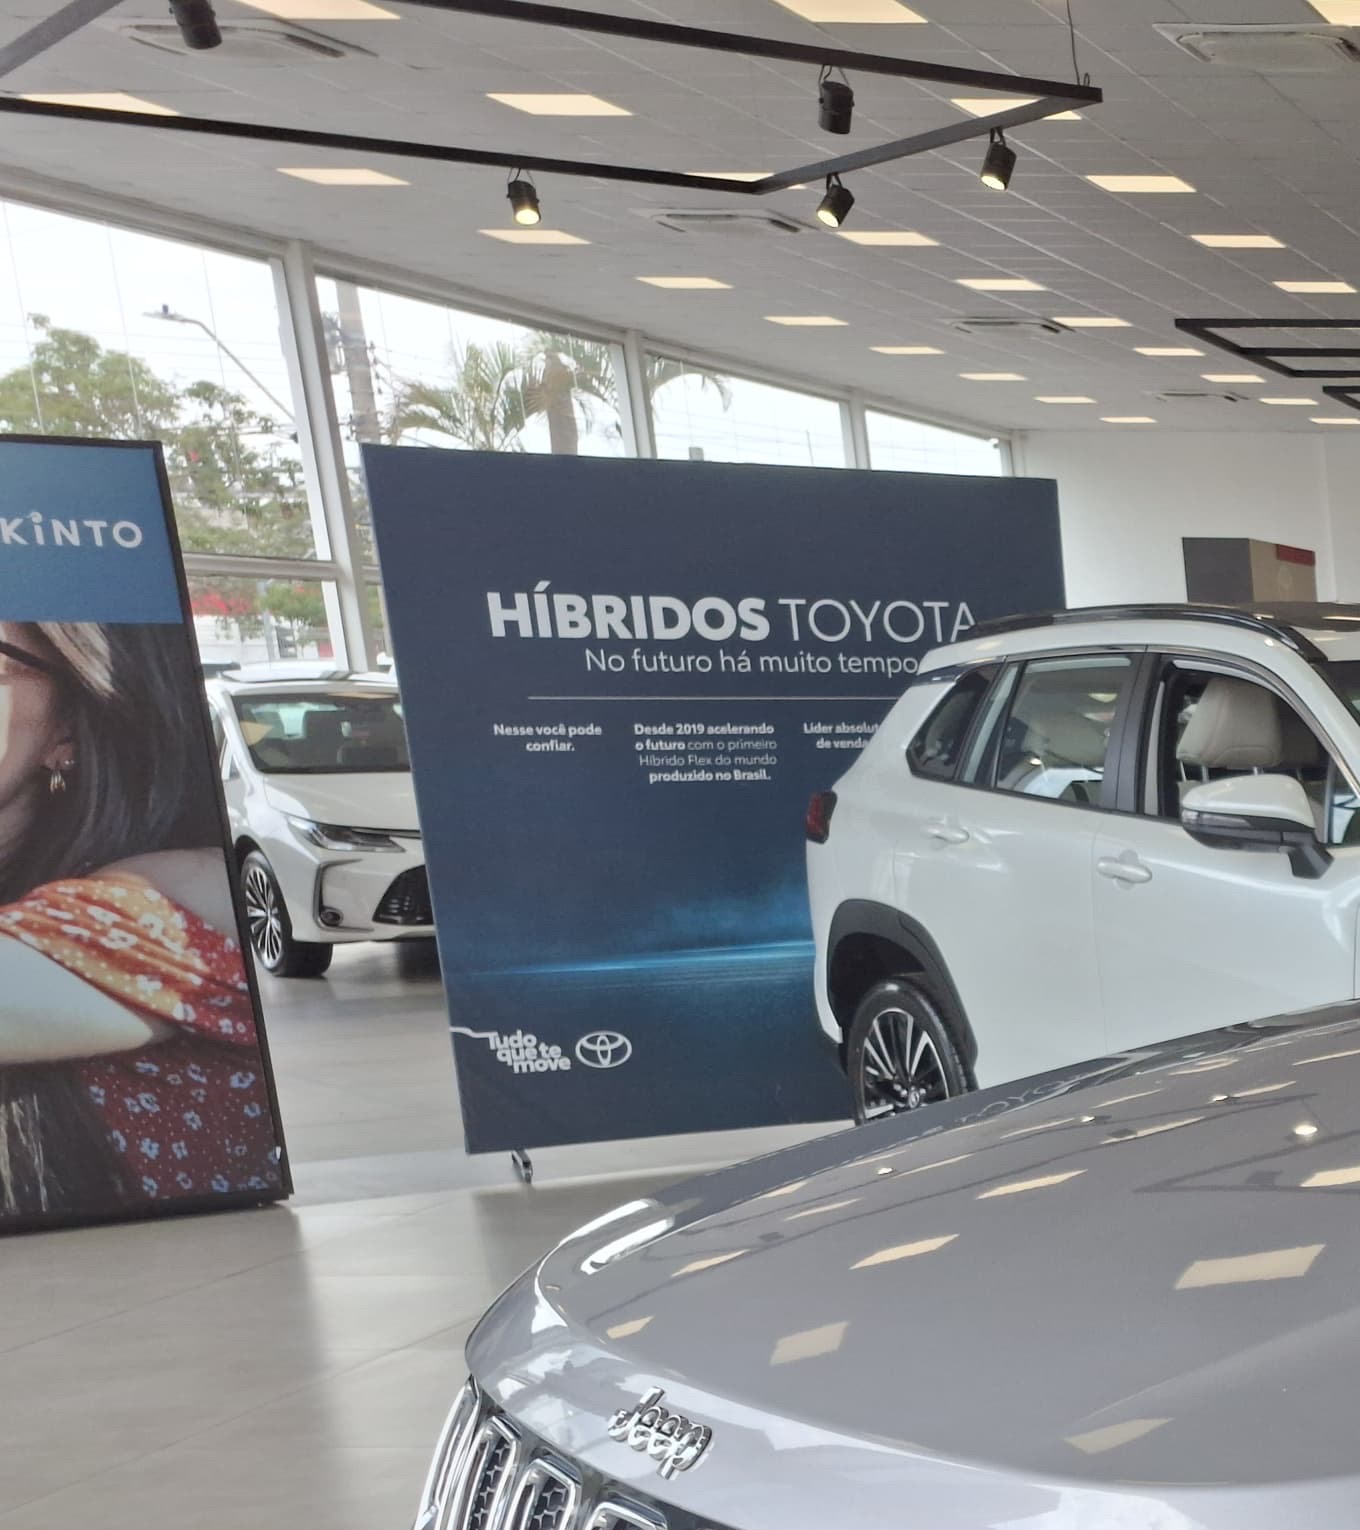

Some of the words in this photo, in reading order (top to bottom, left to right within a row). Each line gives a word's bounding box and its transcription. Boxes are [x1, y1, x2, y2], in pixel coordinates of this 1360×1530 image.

[487, 580, 770, 642] HÍBRIDOS
[778, 598, 976, 643] TOYOTA
[585, 648, 625, 672] No
[632, 648, 713, 673] futuro
[720, 649, 751, 673] há
[760, 651, 832, 673] muito
[838, 652, 918, 678] tempo
[493, 724, 534, 736] Nesse
[536, 723, 566, 736] você
[568, 723, 602, 738] pode
[634, 723, 674, 735] Desde
[675, 723, 705, 735] 2019
[707, 722, 774, 735] acelerando
[526, 739, 575, 752] confiar.
[635, 741, 644, 751] o
[645, 739, 686, 751] futuro
[688, 741, 713, 750] com
[717, 741, 725, 750] o
[728, 739, 777, 752] primeiro
[816, 736, 832, 749] de
[688, 754, 712, 766] Flex
[715, 754, 731, 766] do
[734, 753, 777, 766] mundo
[649, 769, 713, 784] produzido
[715, 771, 731, 781] no
[734, 769, 771, 781] Brasil.
[487, 1030, 537, 1050] Tudo
[496, 1048, 537, 1066] que
[539, 1041, 562, 1058] te
[513, 1055, 571, 1074] move
[607, 1385, 712, 1480] Jeep
